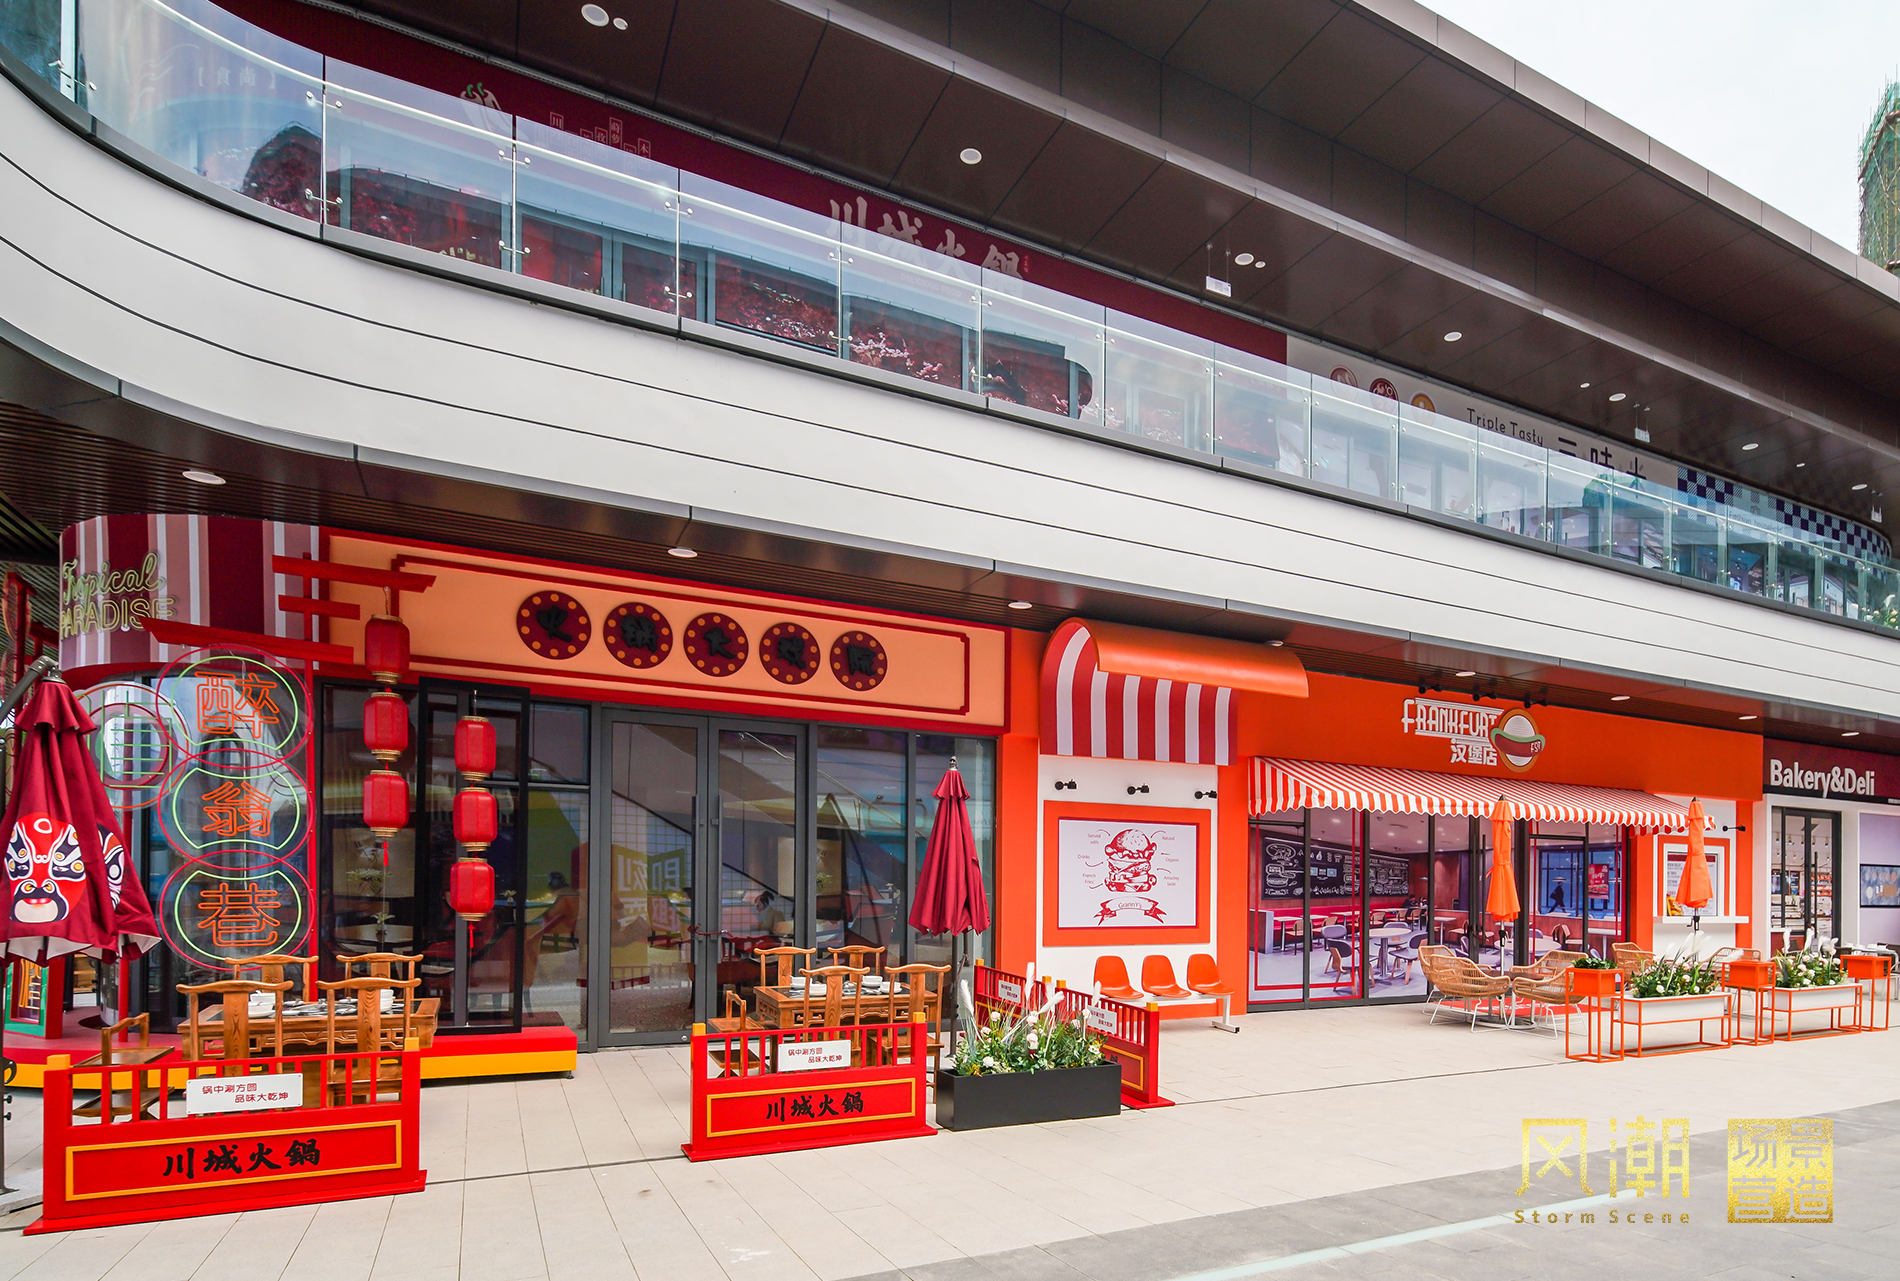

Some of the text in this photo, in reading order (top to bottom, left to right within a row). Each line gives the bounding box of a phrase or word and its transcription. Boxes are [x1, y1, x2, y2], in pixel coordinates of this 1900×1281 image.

[901, 272, 962, 298] DELICIOUS FOOD
[1466, 407, 1506, 435] Triple
[1510, 421, 1544, 447] Tasty
[63, 552, 163, 617] Tropical
[60, 598, 175, 639] PARADISE
[1401, 698, 1498, 738] FRANKFURT
[1450, 738, 1498, 767] 汉堡店
[1769, 758, 1875, 799] Bakery&Deli
[194, 671, 281, 948] 醉翁巷
[766, 1091, 864, 1122] 川城火鍋
[163, 1138, 321, 1179] 川城火鍋
